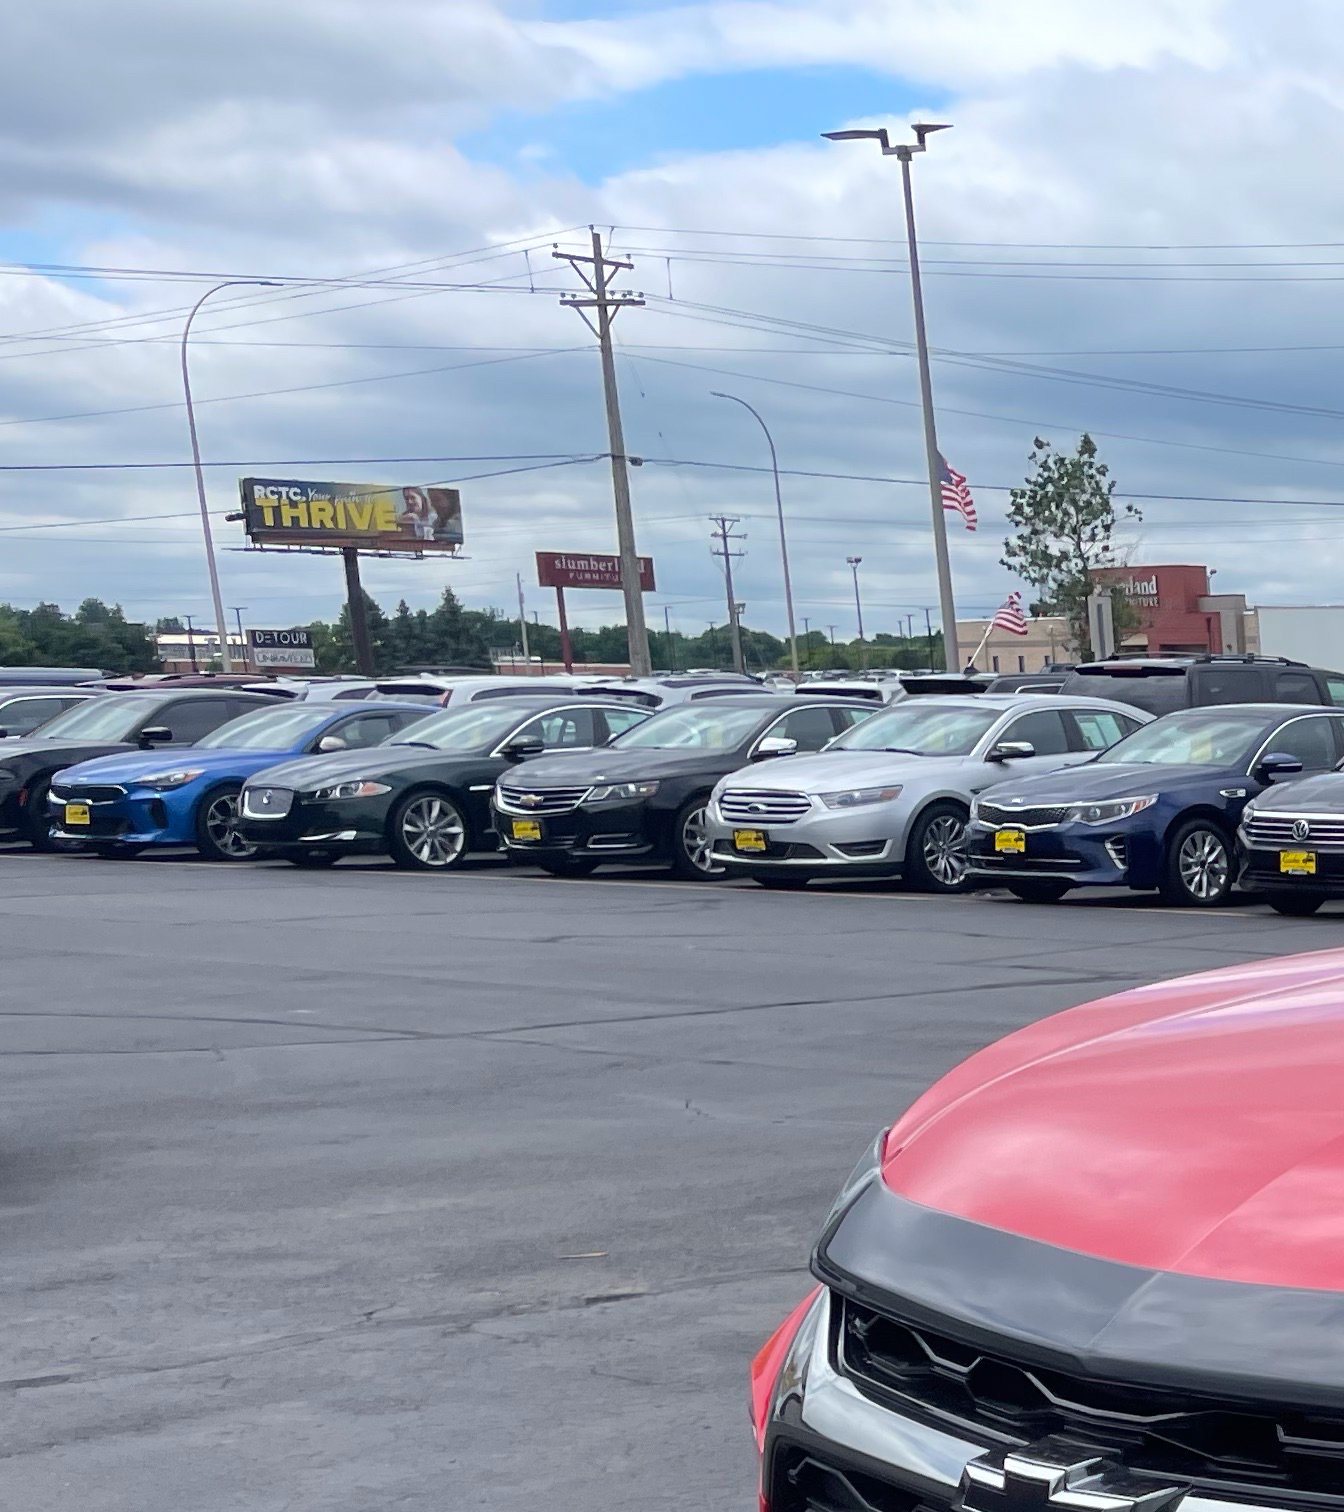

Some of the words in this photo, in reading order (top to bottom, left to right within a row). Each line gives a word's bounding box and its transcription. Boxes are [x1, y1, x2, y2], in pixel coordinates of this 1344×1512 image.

[253, 485, 306, 502] RCTC.
[255, 498, 402, 532] THRIVE.
[256, 631, 307, 644] DETOUR
